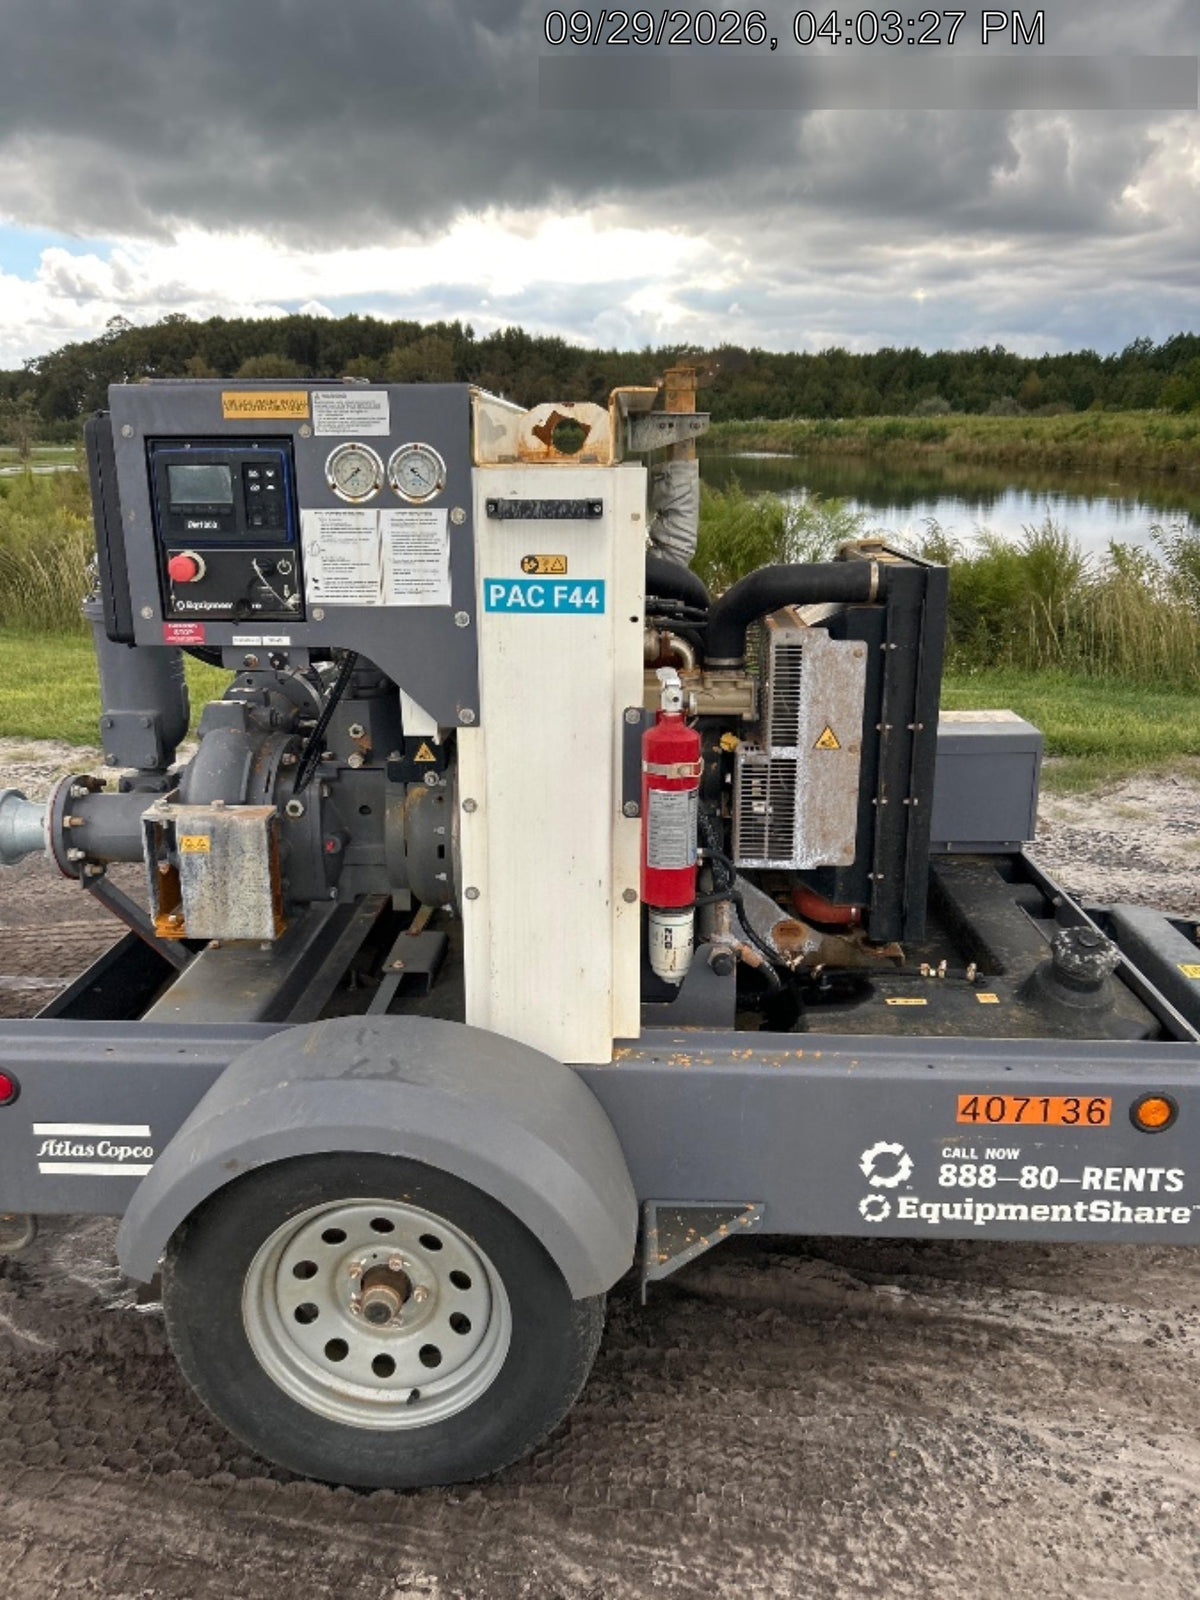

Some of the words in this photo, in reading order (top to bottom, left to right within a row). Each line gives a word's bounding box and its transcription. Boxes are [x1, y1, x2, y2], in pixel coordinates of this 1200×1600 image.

[490, 584, 545, 608] PAC
[554, 585, 600, 609] F44
[960, 1095, 1107, 1125] 407136
[37, 1139, 95, 1158] Atlas
[96, 1140, 154, 1161] Copco
[942, 1147, 979, 1160] CALL
[984, 1148, 1021, 1161] NOW
[896, 1197, 1192, 1226] EquipmentShare
